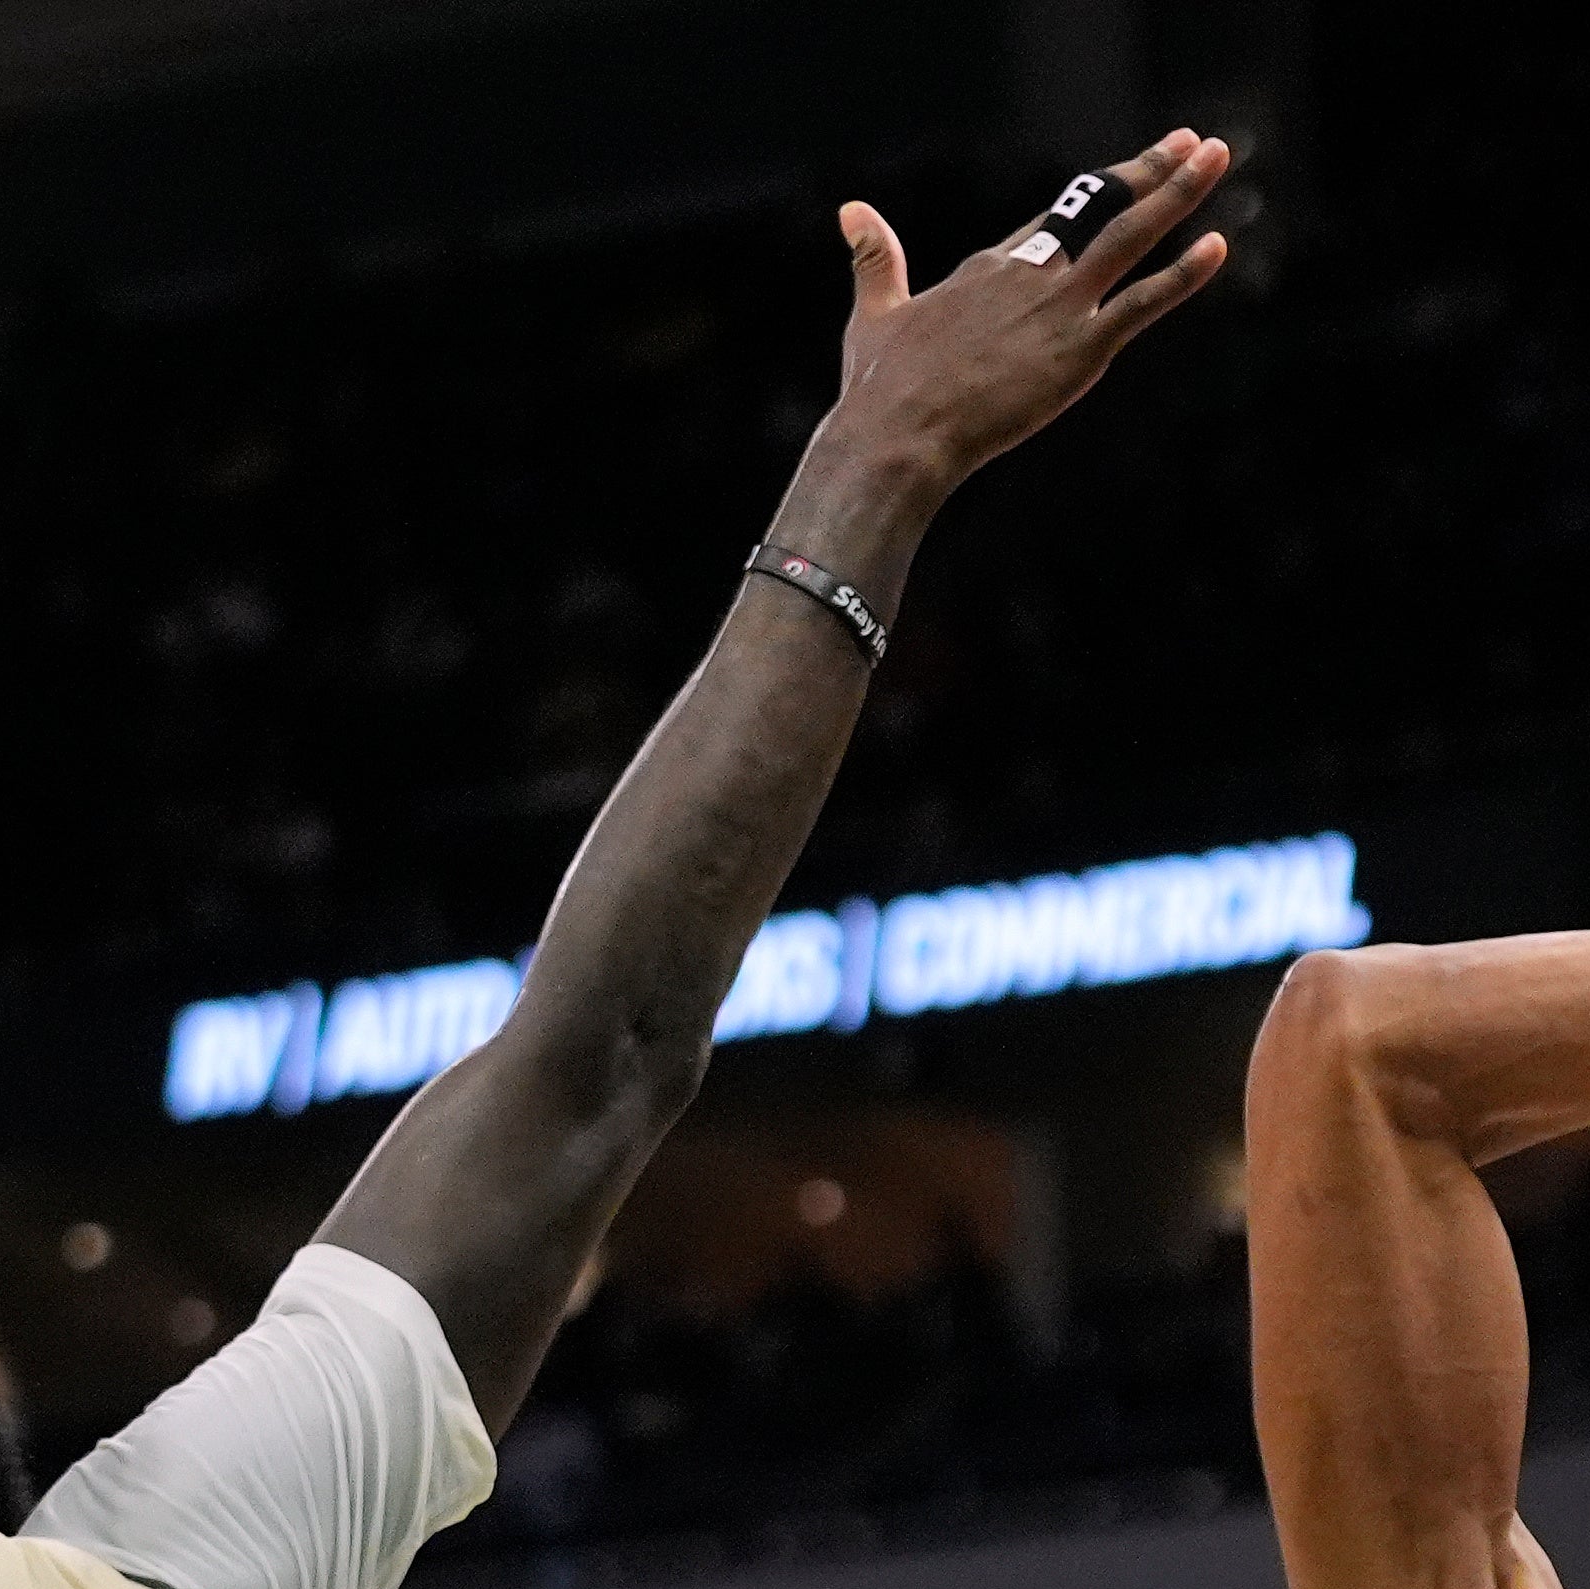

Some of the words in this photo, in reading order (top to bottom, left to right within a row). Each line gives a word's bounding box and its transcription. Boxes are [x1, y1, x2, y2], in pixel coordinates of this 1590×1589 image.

[832, 584, 877, 637] Stay
[165, 992, 293, 1122] RV
[875, 832, 1370, 1015] COMMERCIAL
